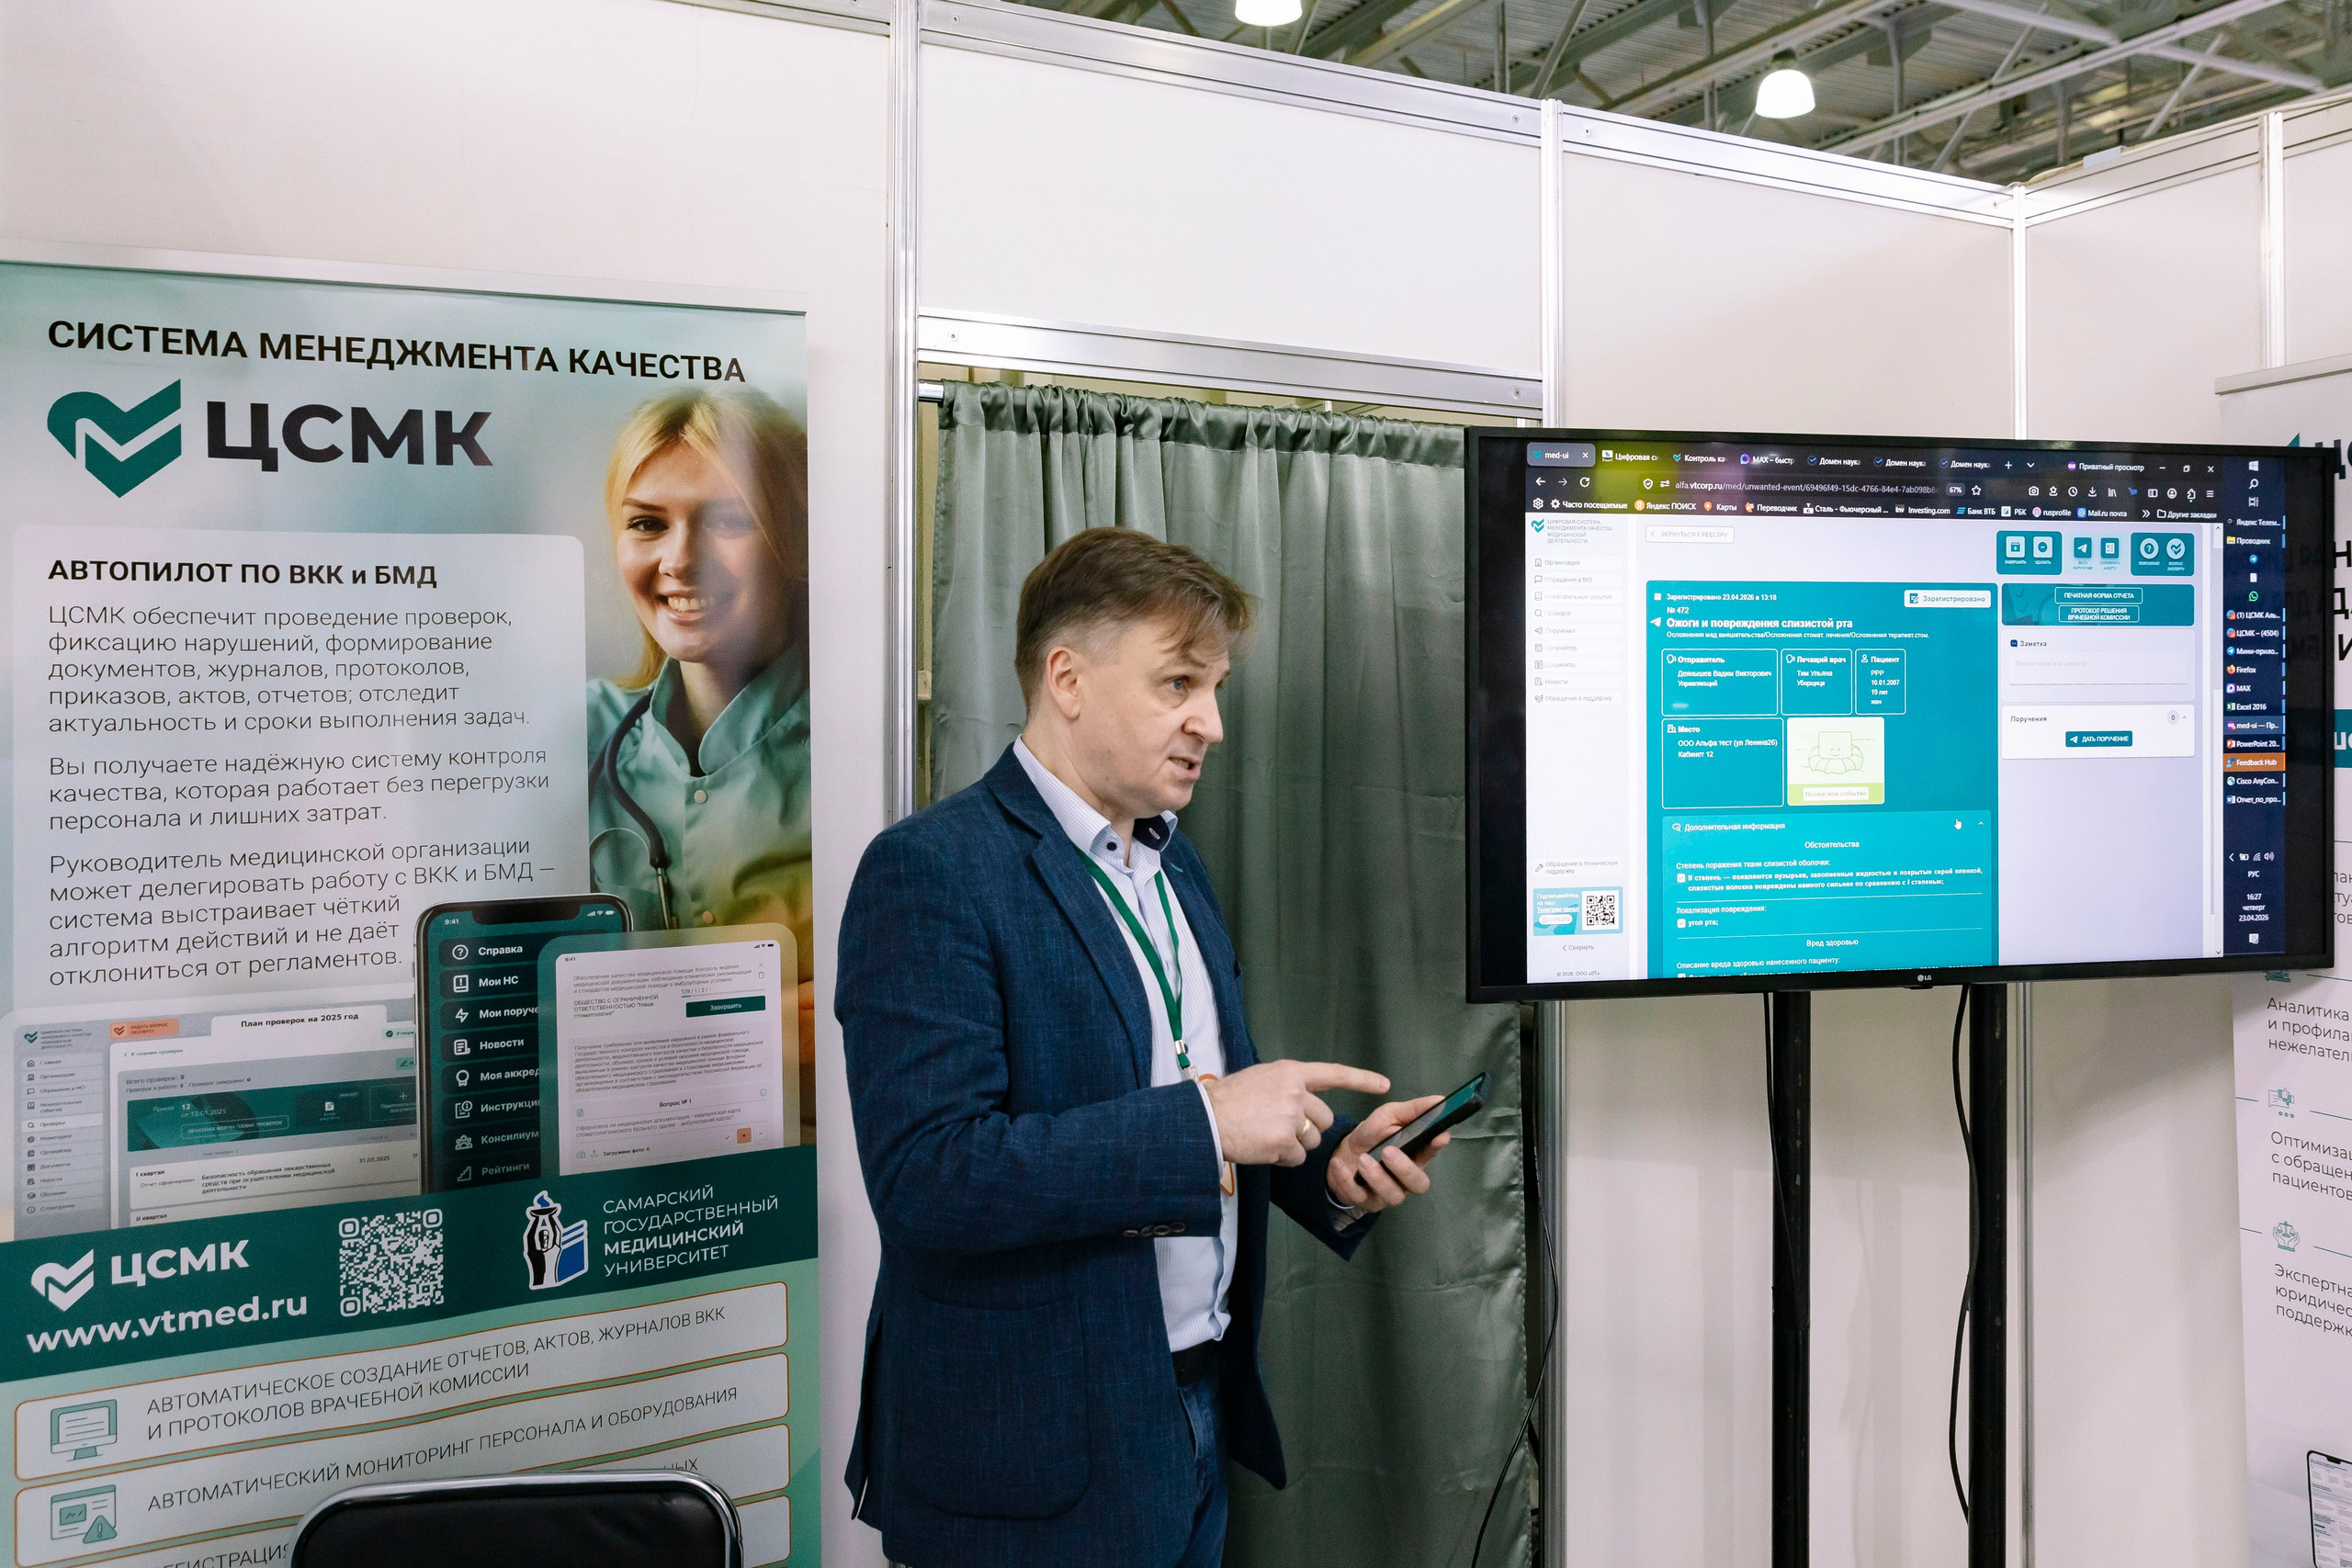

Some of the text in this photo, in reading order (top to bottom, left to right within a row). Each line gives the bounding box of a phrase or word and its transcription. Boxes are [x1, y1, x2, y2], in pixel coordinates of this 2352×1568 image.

[49, 321, 745, 382] СИСТЕМА МЕНЕДЖМЕНТА КАЧЕСТВА
[207, 401, 492, 472] ЦСМК
[2079, 463, 2144, 473] Приватный просмотр
[1586, 502, 1627, 510] посещаемые
[1717, 503, 1737, 512] Карты
[1757, 504, 1797, 513] Переводчик
[1908, 507, 1950, 515] Investing.com
[48, 560, 436, 588] АВТОПИЛОТ ПО ВКК и БМД
[1923, 595, 1985, 604] Зарегистрировано
[51, 606, 511, 629] ЦСМК обеспечит проведение проверок,
[1667, 618, 1700, 628] Ожоги
[1711, 619, 1779, 629] повреждения
[1782, 618, 1834, 628] слизистой
[1836, 620, 1852, 630] рта
[50, 633, 492, 655] фиксацию нарушений, формирование
[1678, 656, 1724, 664] Отправитель
[1796, 656, 1828, 664] Лечащий
[1871, 656, 1900, 664] Пациент
[49, 662, 469, 682] документов, журналов, протоколов,
[51, 688, 459, 708] приказов, актов, отчетов; отследит
[50, 712, 530, 736] актуальность и сроки выполнения задач.
[2010, 716, 2047, 725] Поручения
[51, 751, 545, 778] Вы получаете надёжную систему контроля
[51, 776, 548, 802] качества, которая работает без перегрузки
[51, 807, 387, 833] персонала и лишних затрат.
[1684, 824, 1741, 832] Дополнительная
[1804, 840, 1860, 849] Обстоятельства
[51, 841, 528, 877] Руководитель медицинской организации
[2248, 870, 2259, 878] РУС
[2246, 893, 2261, 901] 16:27
[51, 895, 399, 930] система выстраивает чёткий
[479, 946, 523, 956] Справка
[480, 976, 518, 987] Мои НС
[480, 1010, 502, 1018] Мои
[2267, 998, 2349, 1021] Аналитика
[266, 1017, 305, 1026] проверок
[2268, 1020, 2352, 1042] и профила
[480, 1039, 524, 1049] Новости
[2269, 1039, 2352, 1062] нежелател
[481, 1072, 502, 1080] Моя
[481, 1131, 538, 1145] Консилиум
[481, 1163, 529, 1175] Рейтинги
[2272, 1154, 2352, 1180] с обращен
[2273, 1172, 2352, 1201] пациентов
[603, 1184, 715, 1214] САМАРСКИЙ
[604, 1195, 778, 1235] ГОСУДАРСТВЕННЫЙ
[604, 1221, 744, 1257] МЕДИЦИНСКИЙ
[111, 1240, 249, 1287] ЦСМК
[604, 1245, 729, 1277] УНИВЕРСИТЕТ
[27, 1294, 308, 1353] www.vtmed.ru
[147, 1307, 724, 1415] АВТОМАТИЧЕСКОЕ СОЗДАНИЕ ОТЧЕТОВ, АКТОВ, ЖУРНАЛОВ ВКК
[149, 1363, 529, 1439] И ПРОТОКОЛОВ ВРАЧЕБНОЙ КОМИССИИ
[147, 1388, 737, 1512] АВТОМАТИЧЕСКИЙ МОНИТОРИНГ ПЕРСОНАЛА И ОБОРУДОВАНИЯ
